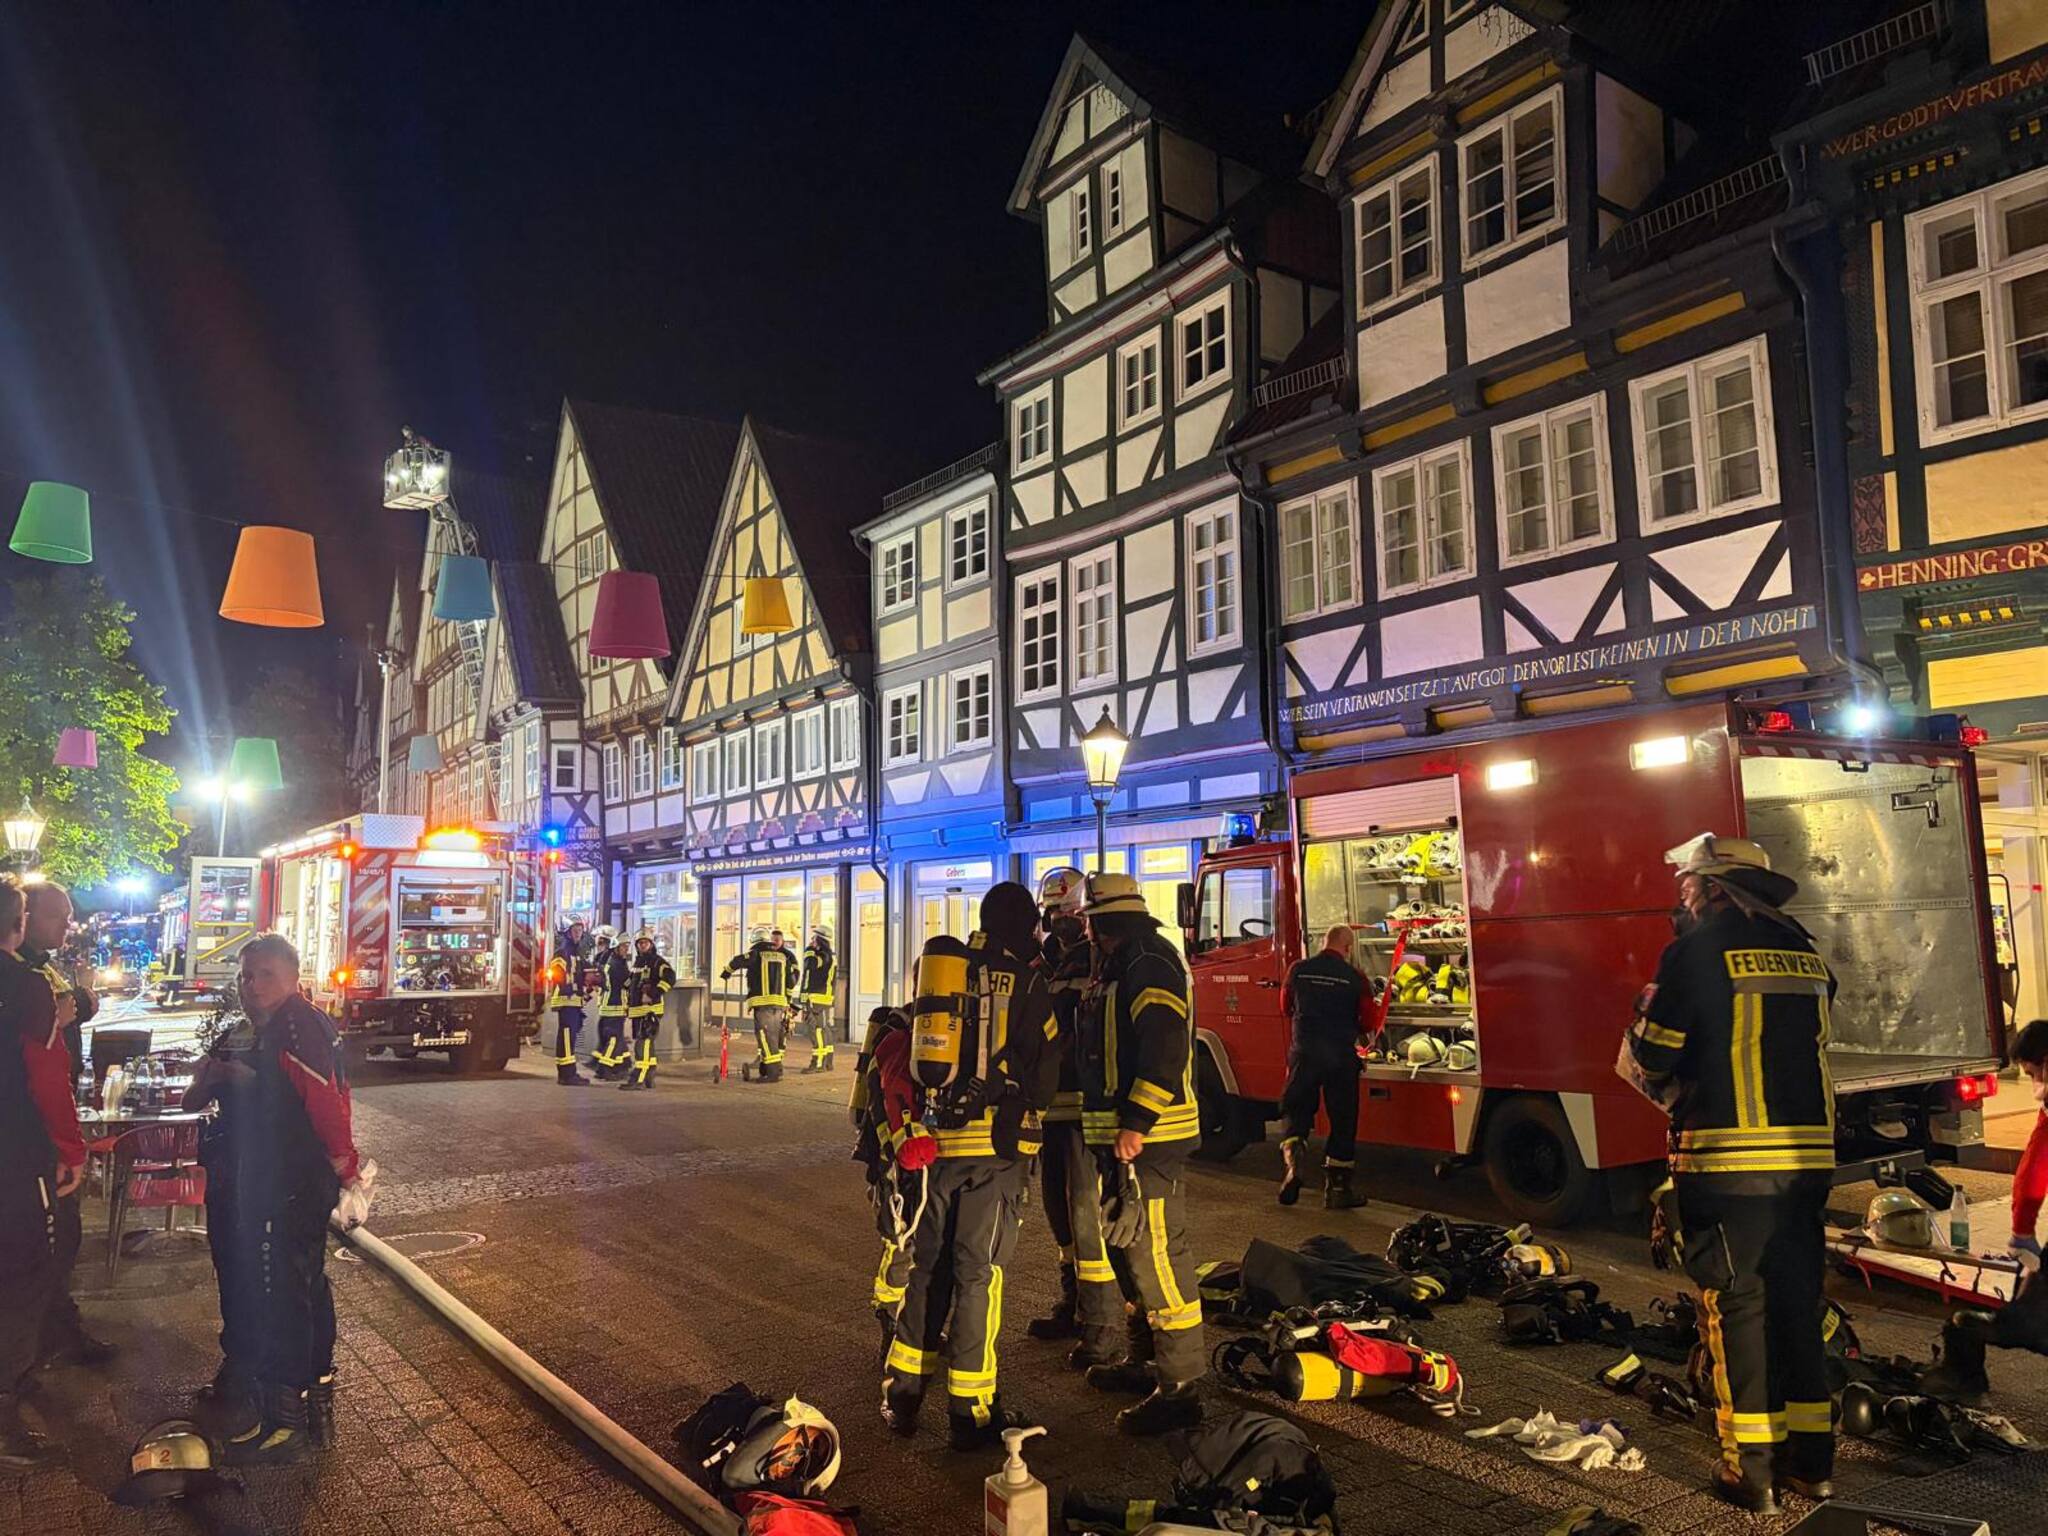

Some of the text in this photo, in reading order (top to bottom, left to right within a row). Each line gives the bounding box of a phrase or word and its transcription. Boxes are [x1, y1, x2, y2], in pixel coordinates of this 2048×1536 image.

[1877, 540, 2048, 589] HENNING GR
[1665, 629, 1690, 656] IN
[1700, 619, 1742, 649] DER
[1731, 952, 1827, 977] FEUERWEHR
